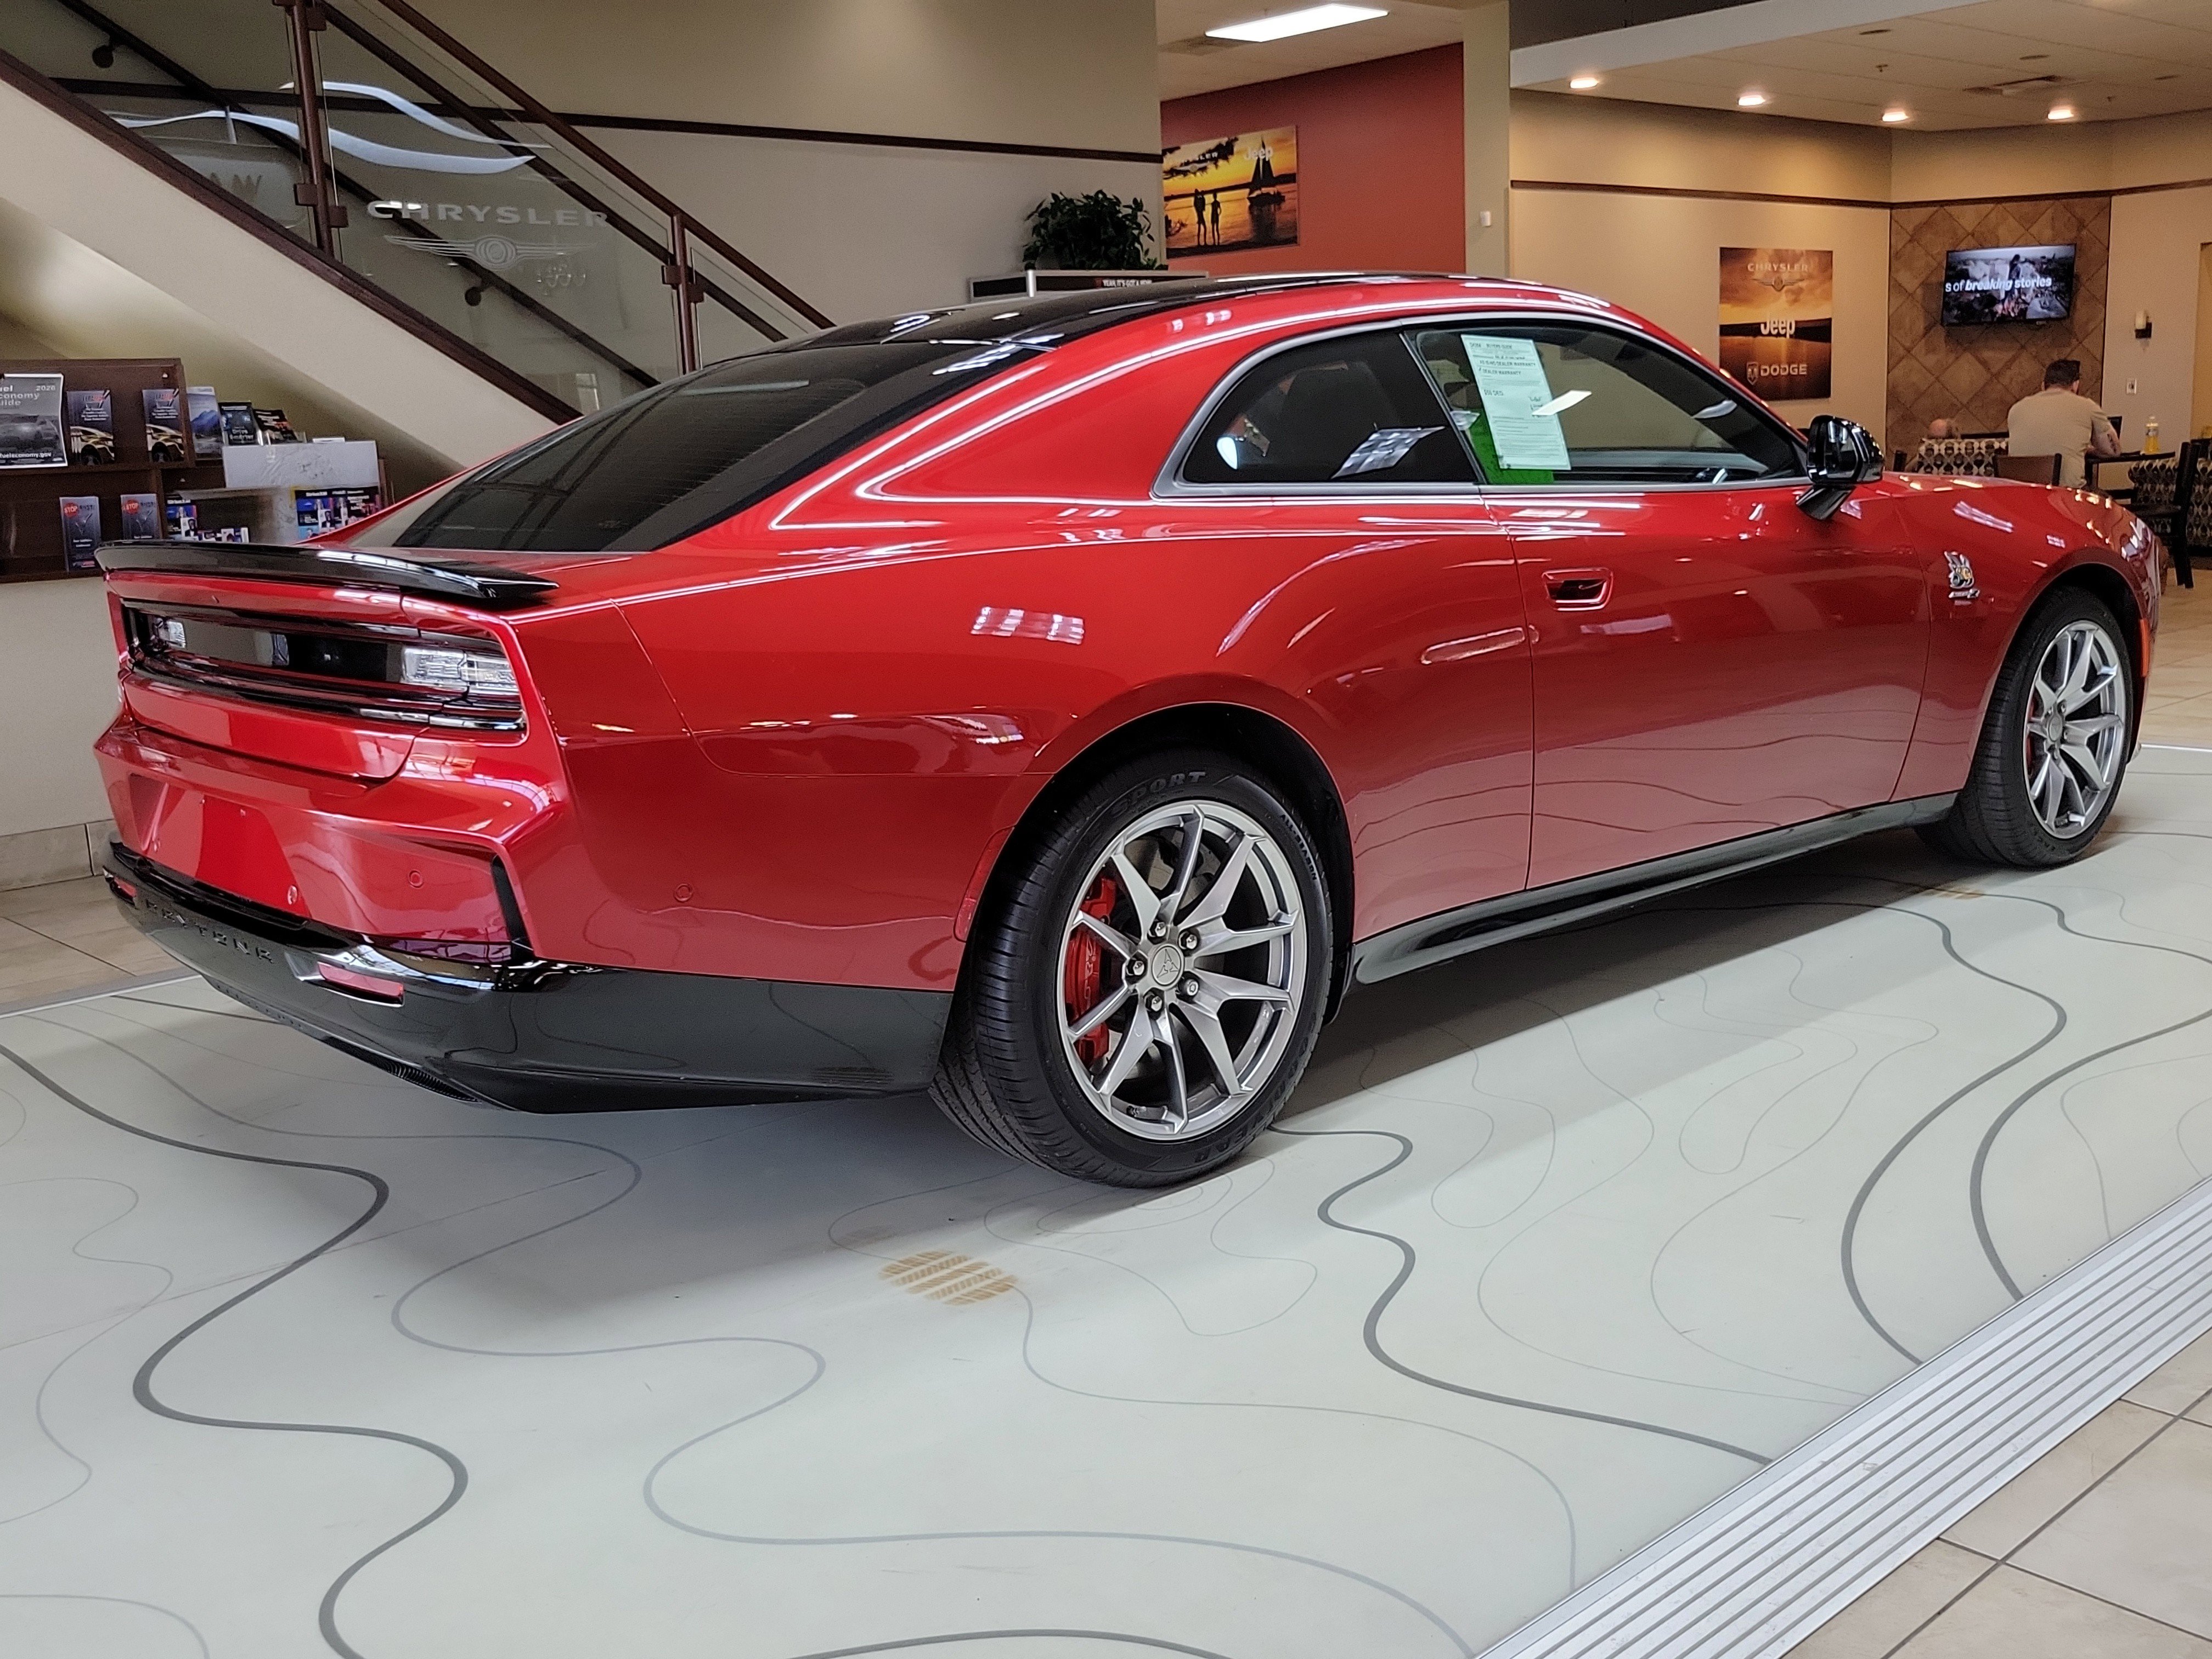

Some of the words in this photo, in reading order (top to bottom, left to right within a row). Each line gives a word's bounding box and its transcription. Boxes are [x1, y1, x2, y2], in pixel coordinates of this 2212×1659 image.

[367, 200, 608, 228] CHRYSLER
[1747, 263, 1808, 272] CHRYSLER
[1953, 279, 1966, 292] of
[1965, 278, 2013, 291] breaking
[2015, 277, 2052, 289] stories
[1760, 317, 1796, 339] Jeep
[1760, 364, 1808, 377] DODGE
[64, 505, 78, 514] STOP
